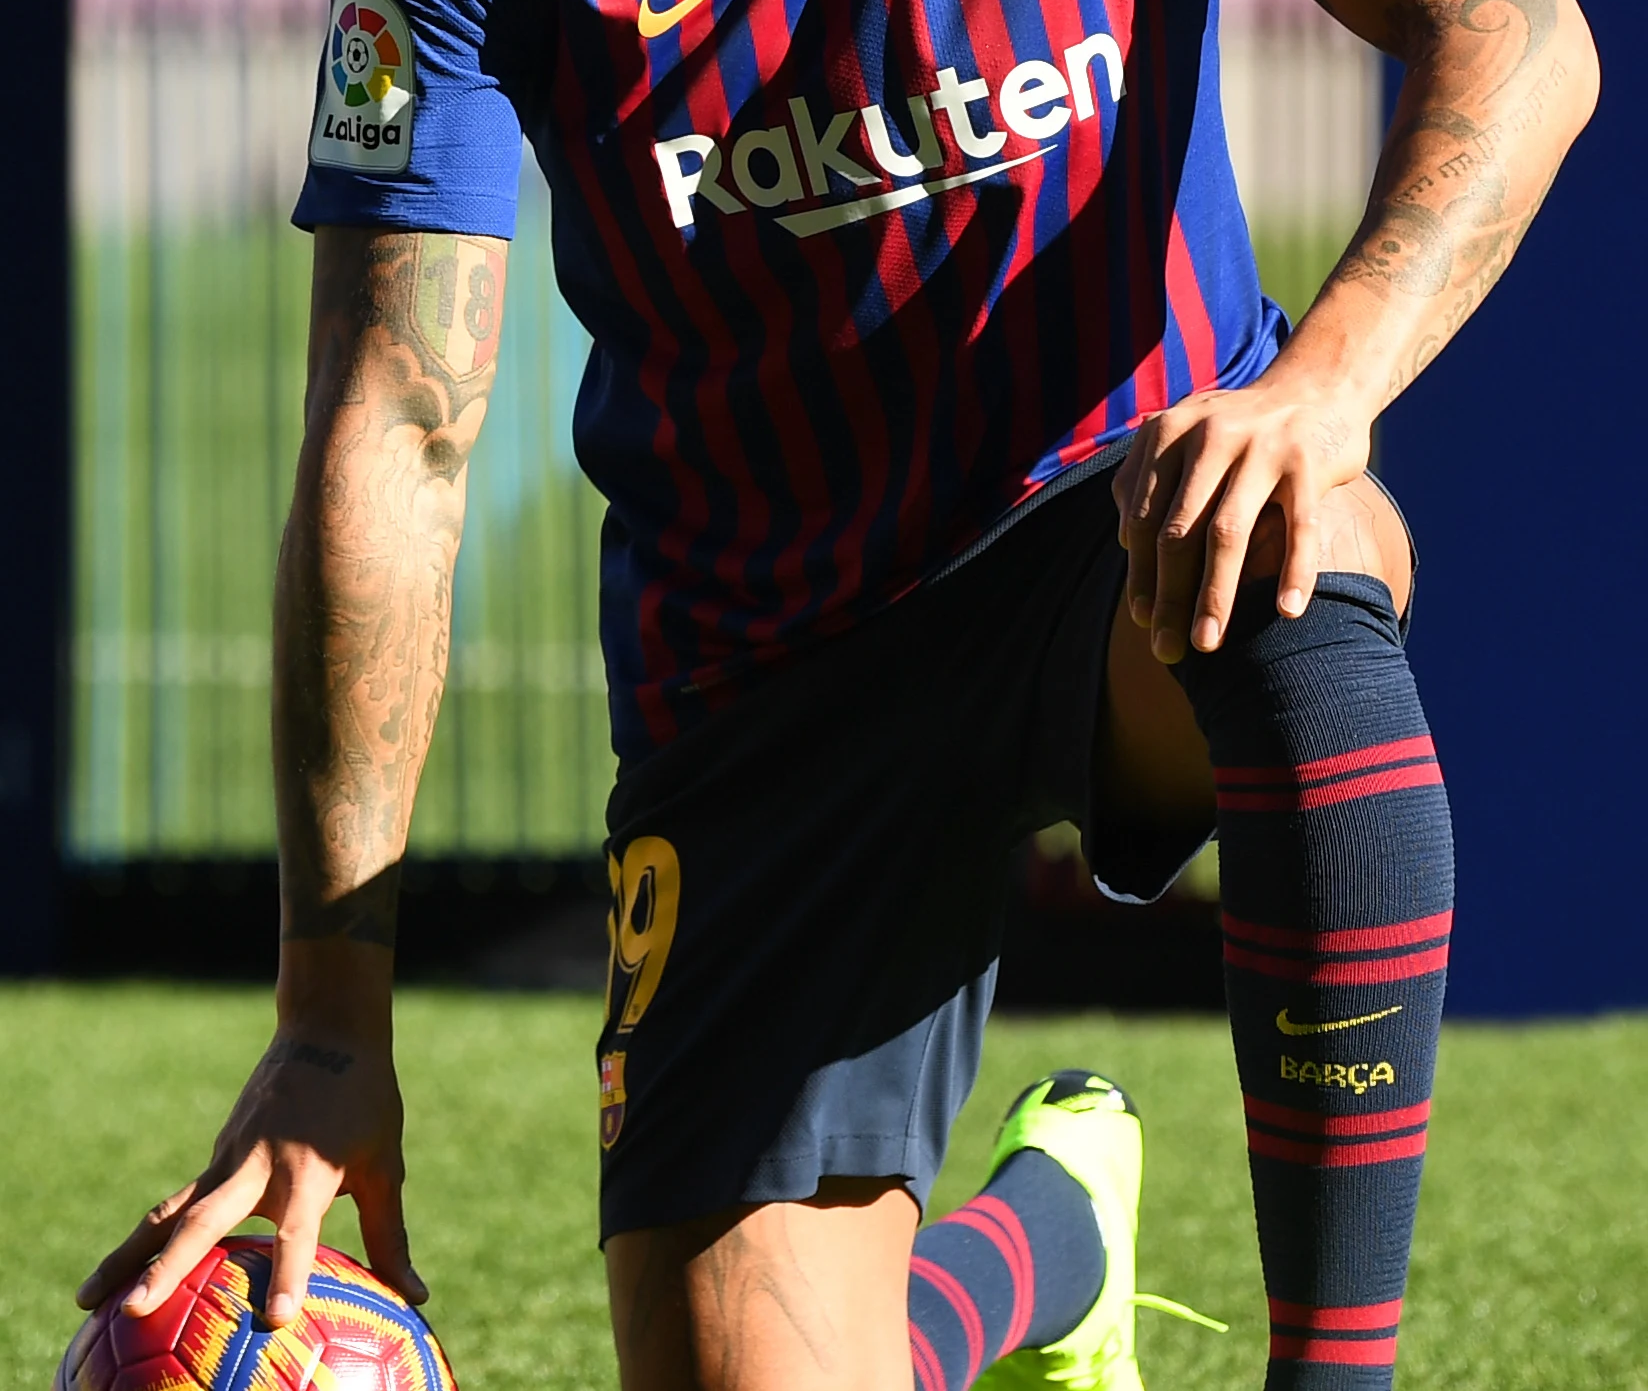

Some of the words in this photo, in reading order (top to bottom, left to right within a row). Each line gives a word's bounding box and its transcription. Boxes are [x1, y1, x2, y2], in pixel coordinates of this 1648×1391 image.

[654, 32, 1127, 229] Rakuten
[425, 254, 496, 341] 18
[605, 836, 681, 1034] 9
[1280, 1055, 1395, 1095] BARÇA
